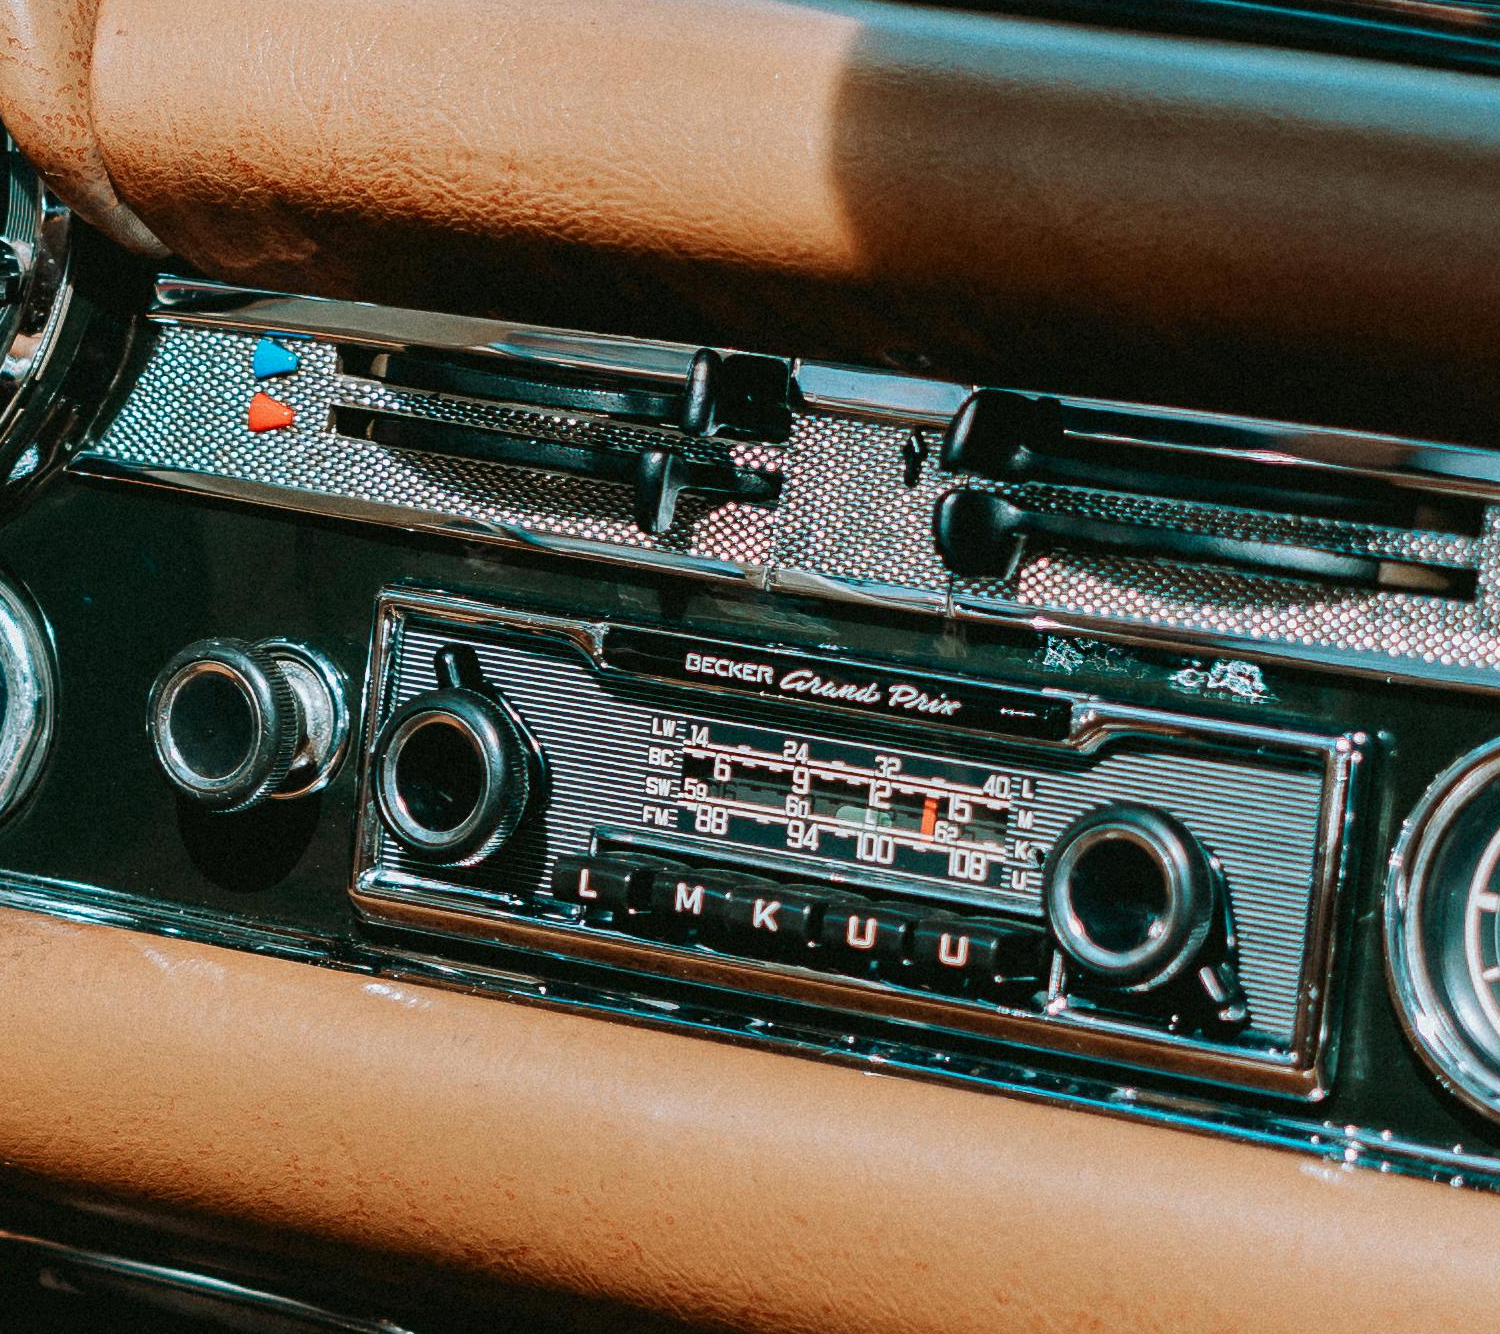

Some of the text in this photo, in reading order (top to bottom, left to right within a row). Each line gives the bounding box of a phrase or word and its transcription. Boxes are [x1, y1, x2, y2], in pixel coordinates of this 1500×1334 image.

[685, 652, 962, 716] BECKER Grand Prix
[648, 746, 1033, 829] BC 6 9 12 15 M
[652, 718, 1034, 799] LW 14 24 32 40 L
[644, 805, 1026, 891] FM 88 94 100 108 U
[645, 776, 671, 797] SW
[684, 776, 708, 801] 59
[785, 794, 810, 818] 60
[934, 820, 958, 844] 62
[578, 868, 970, 967] L M K U U
